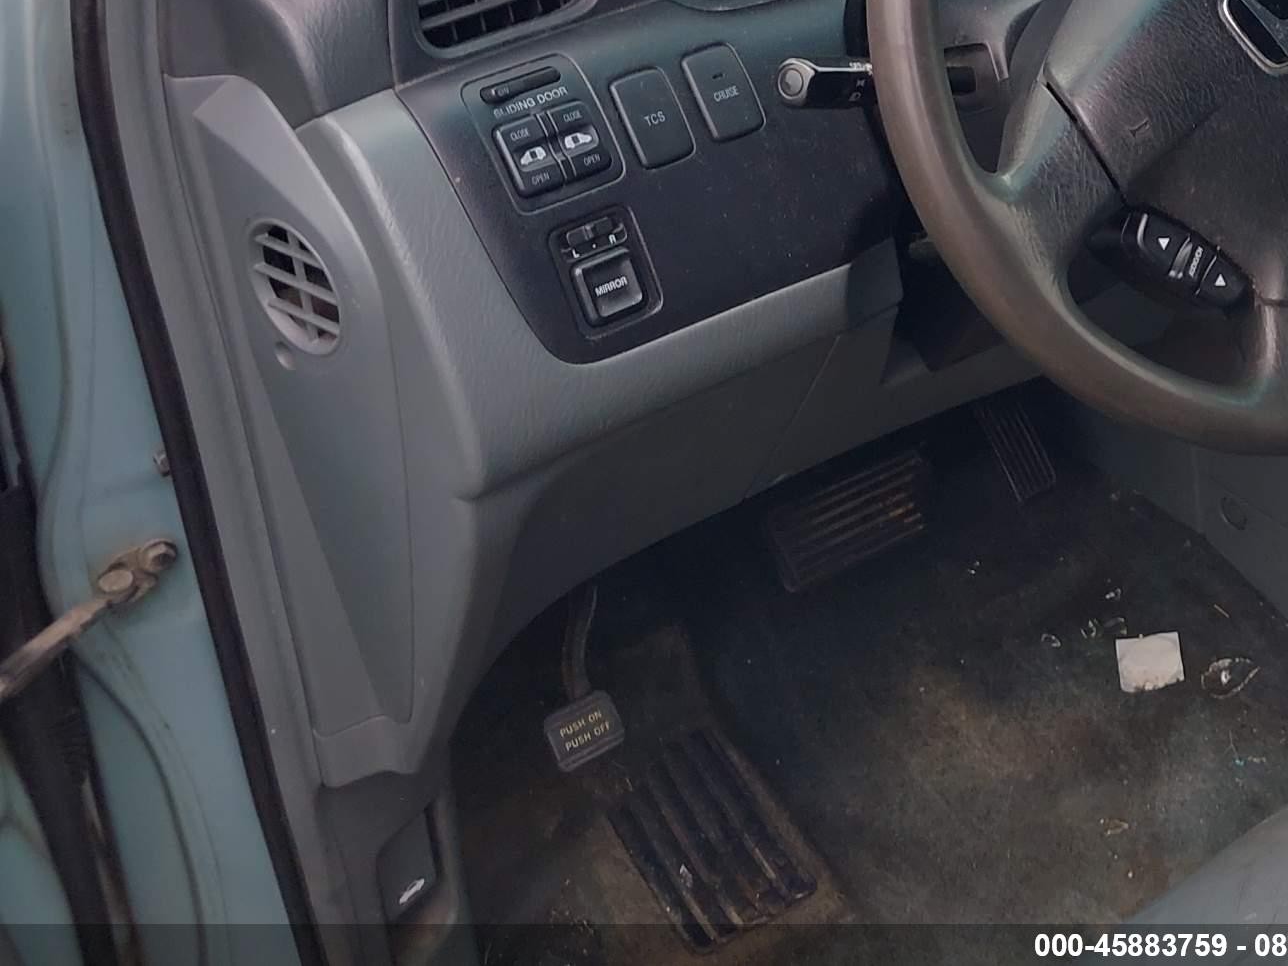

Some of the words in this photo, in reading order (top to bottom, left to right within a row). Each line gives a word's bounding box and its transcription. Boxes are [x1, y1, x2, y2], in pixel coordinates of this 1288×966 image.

[713, 84, 740, 102] CRUISE
[493, 99, 536, 119] SLIDING
[537, 87, 569, 104] DOOR
[563, 108, 584, 123] CLOSE
[644, 111, 666, 126] TCS
[509, 126, 531, 142] CLOSE
[583, 153, 601, 167] OPEN
[531, 171, 551, 186] OPEN
[571, 248, 581, 259] L
[594, 276, 628, 297] MIRROR
[559, 717, 586, 738] PUSH
[588, 708, 602, 723] ON
[565, 731, 592, 752] PUSH
